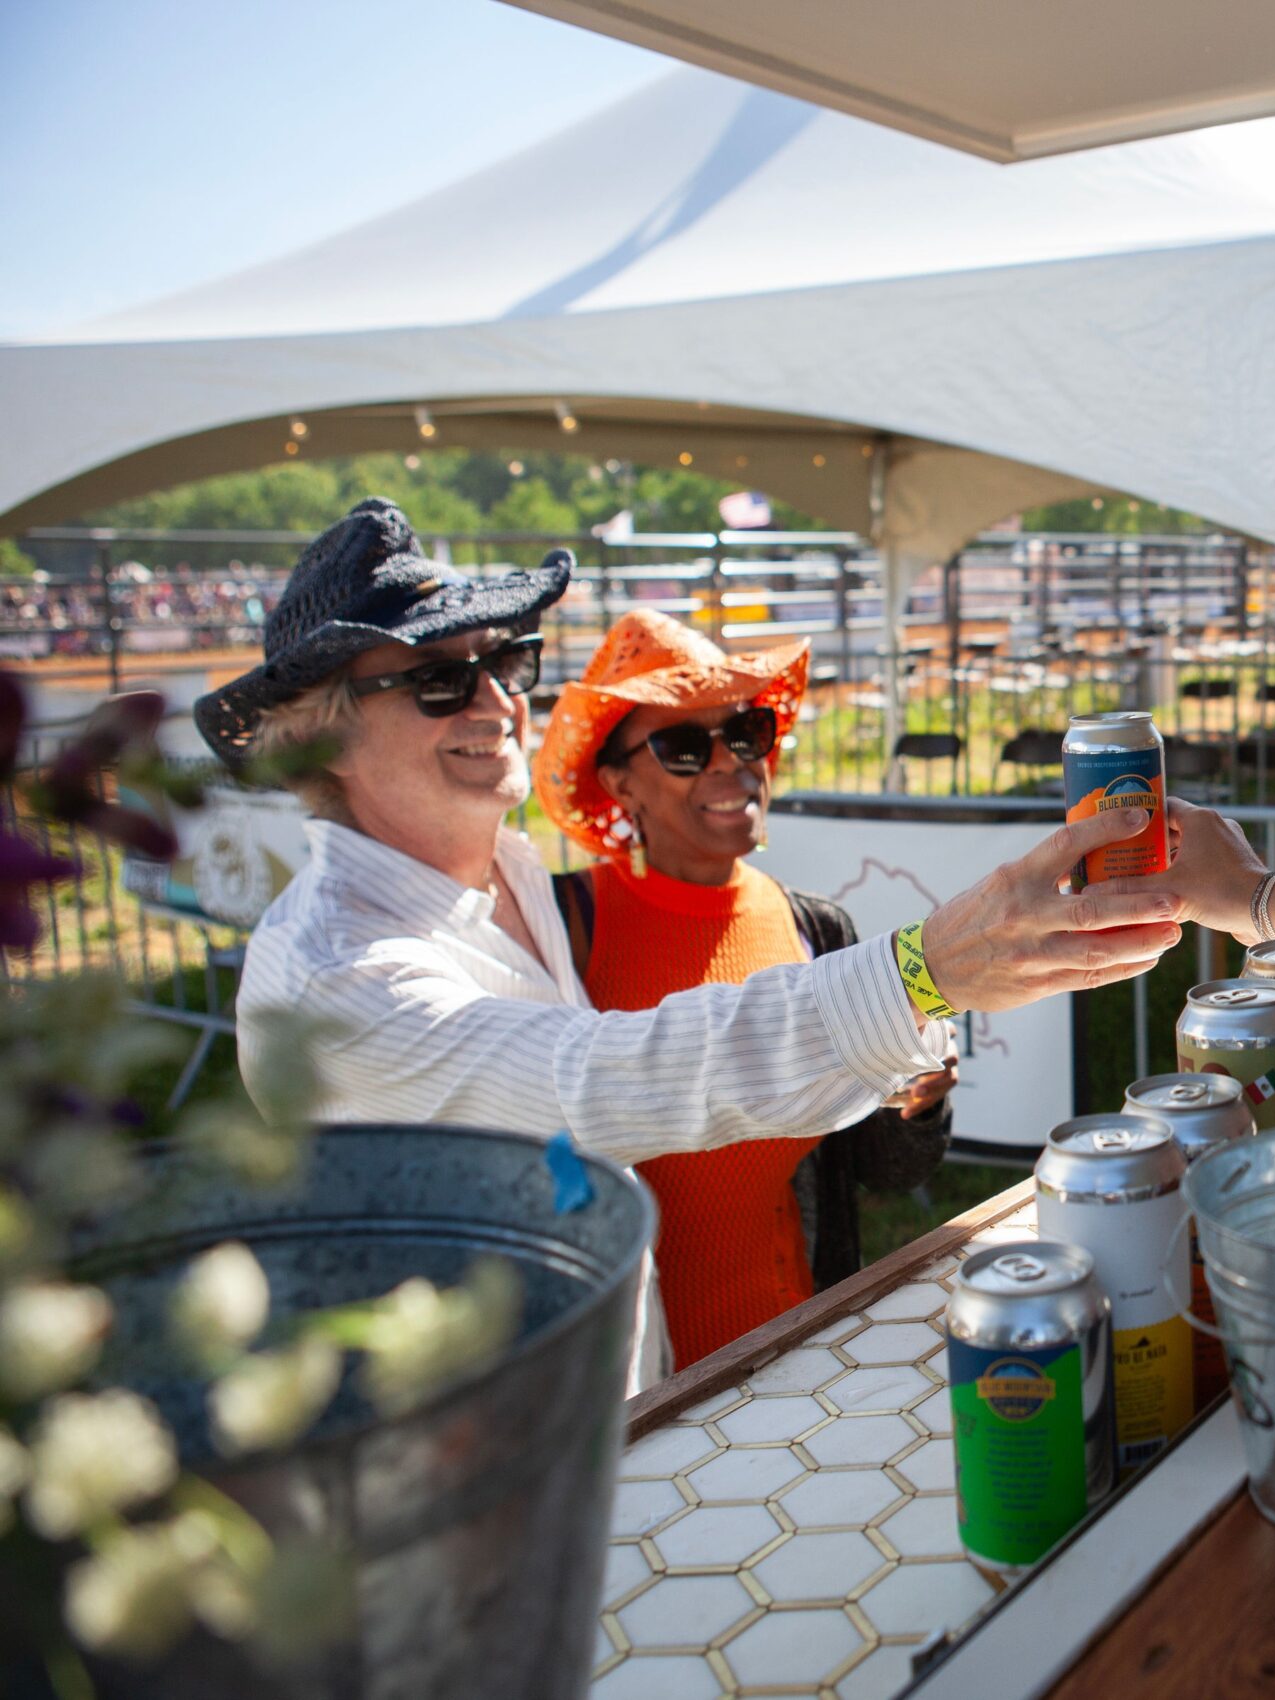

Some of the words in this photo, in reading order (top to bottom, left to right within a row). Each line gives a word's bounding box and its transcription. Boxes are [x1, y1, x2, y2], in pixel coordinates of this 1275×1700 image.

[1098, 797, 1120, 812] BLUE
[1120, 794, 1158, 809] MOUNTAIN
[902, 958, 922, 979] 21
[917, 986, 933, 997] AGE
